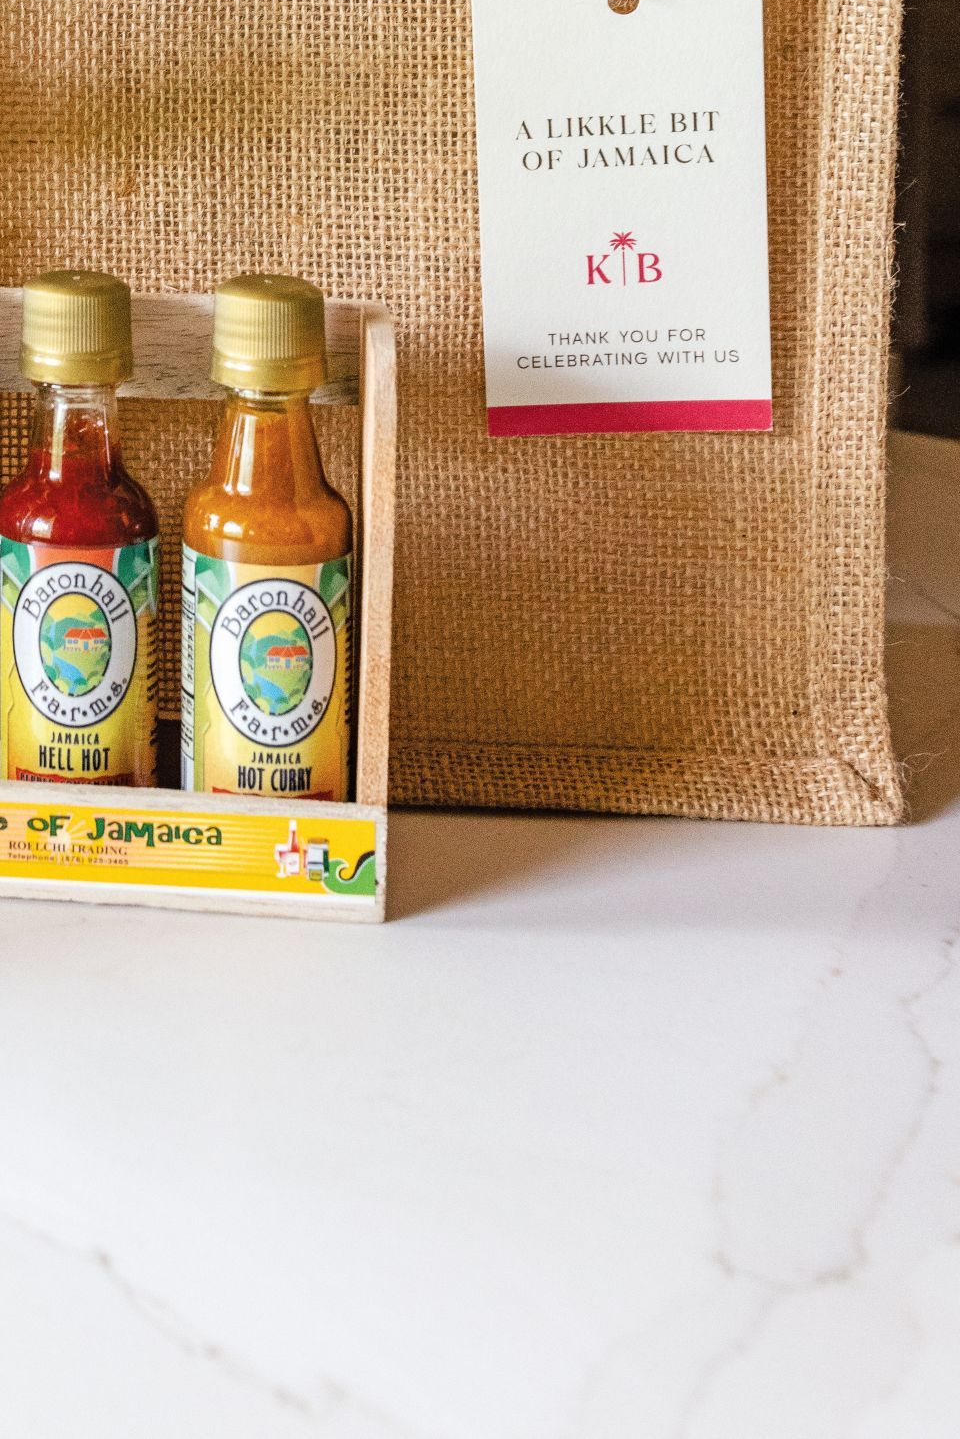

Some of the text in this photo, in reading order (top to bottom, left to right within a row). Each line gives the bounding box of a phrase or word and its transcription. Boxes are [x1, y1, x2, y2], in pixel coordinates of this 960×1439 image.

[515, 111, 720, 140] A LIKKLE BIT
[522, 143, 716, 171] OF JAMAICA
[547, 328, 706, 346] THANK YOU FOR
[517, 350, 740, 369] CELEBRATING WITH US
[22, 572, 130, 625] Baronhall
[220, 590, 330, 640] Baronhall
[50, 731, 100, 745] JAMAICA
[39, 744, 110, 772] HELL HOT
[251, 751, 301, 764] JAMAICA
[237, 765, 313, 792] HOT CURRY
[72, 844, 128, 856] TRADING
